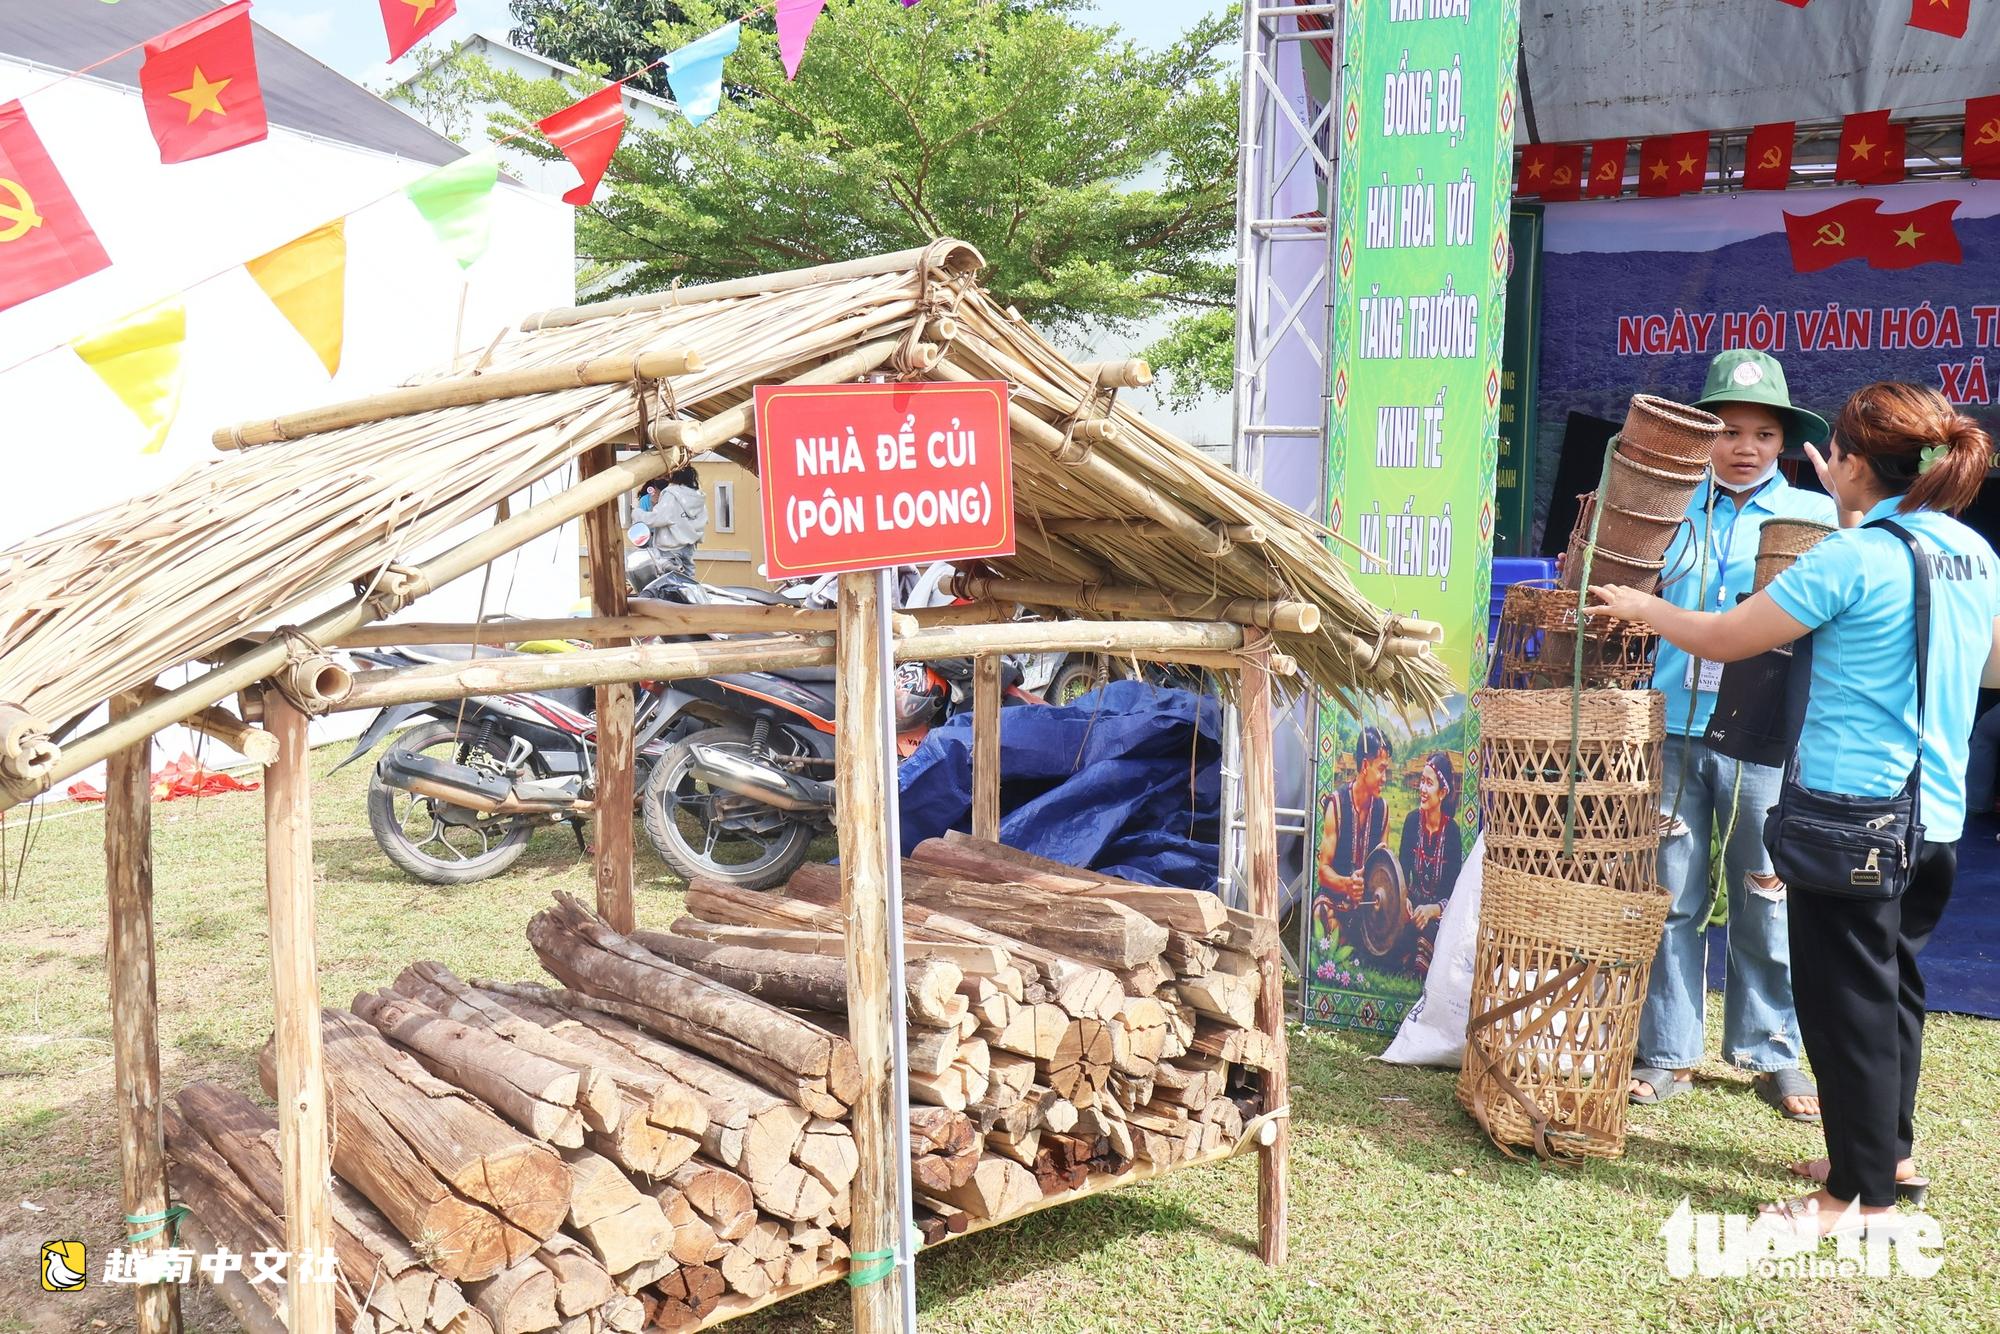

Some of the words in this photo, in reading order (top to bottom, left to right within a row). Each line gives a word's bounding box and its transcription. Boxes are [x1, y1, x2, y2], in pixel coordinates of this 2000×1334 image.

[1383, 49, 1433, 137] ĐỒNG
[1436, 53, 1467, 148] BỘ,
[1365, 172, 1397, 249] HÀI
[1399, 168, 1435, 248] HÒA
[1446, 168, 1477, 247] VỚI
[1359, 283, 1404, 359] TĂNG
[1408, 273, 1478, 358] TRƯỞNG
[1618, 308, 1716, 355] NGÀY
[1794, 302, 1873, 351] VĂN
[1880, 301, 1963, 349] HÓA
[1937, 356, 1990, 405] XÃ
[795, 426, 866, 476] NHÀ
[876, 413, 917, 471] ĐỂ
[927, 417, 977, 469] CỦI
[1376, 407, 1419, 467] KINH
[1423, 386, 1448, 468] TẾ
[786, 487, 865, 544] (PÔN
[875, 481, 992, 531] LOONG)
[1360, 501, 1380, 574] VÀ
[1386, 495, 1425, 576] TIẾN
[1426, 503, 1453, 592] BỘ
[1977, 554, 1988, 580] 4
